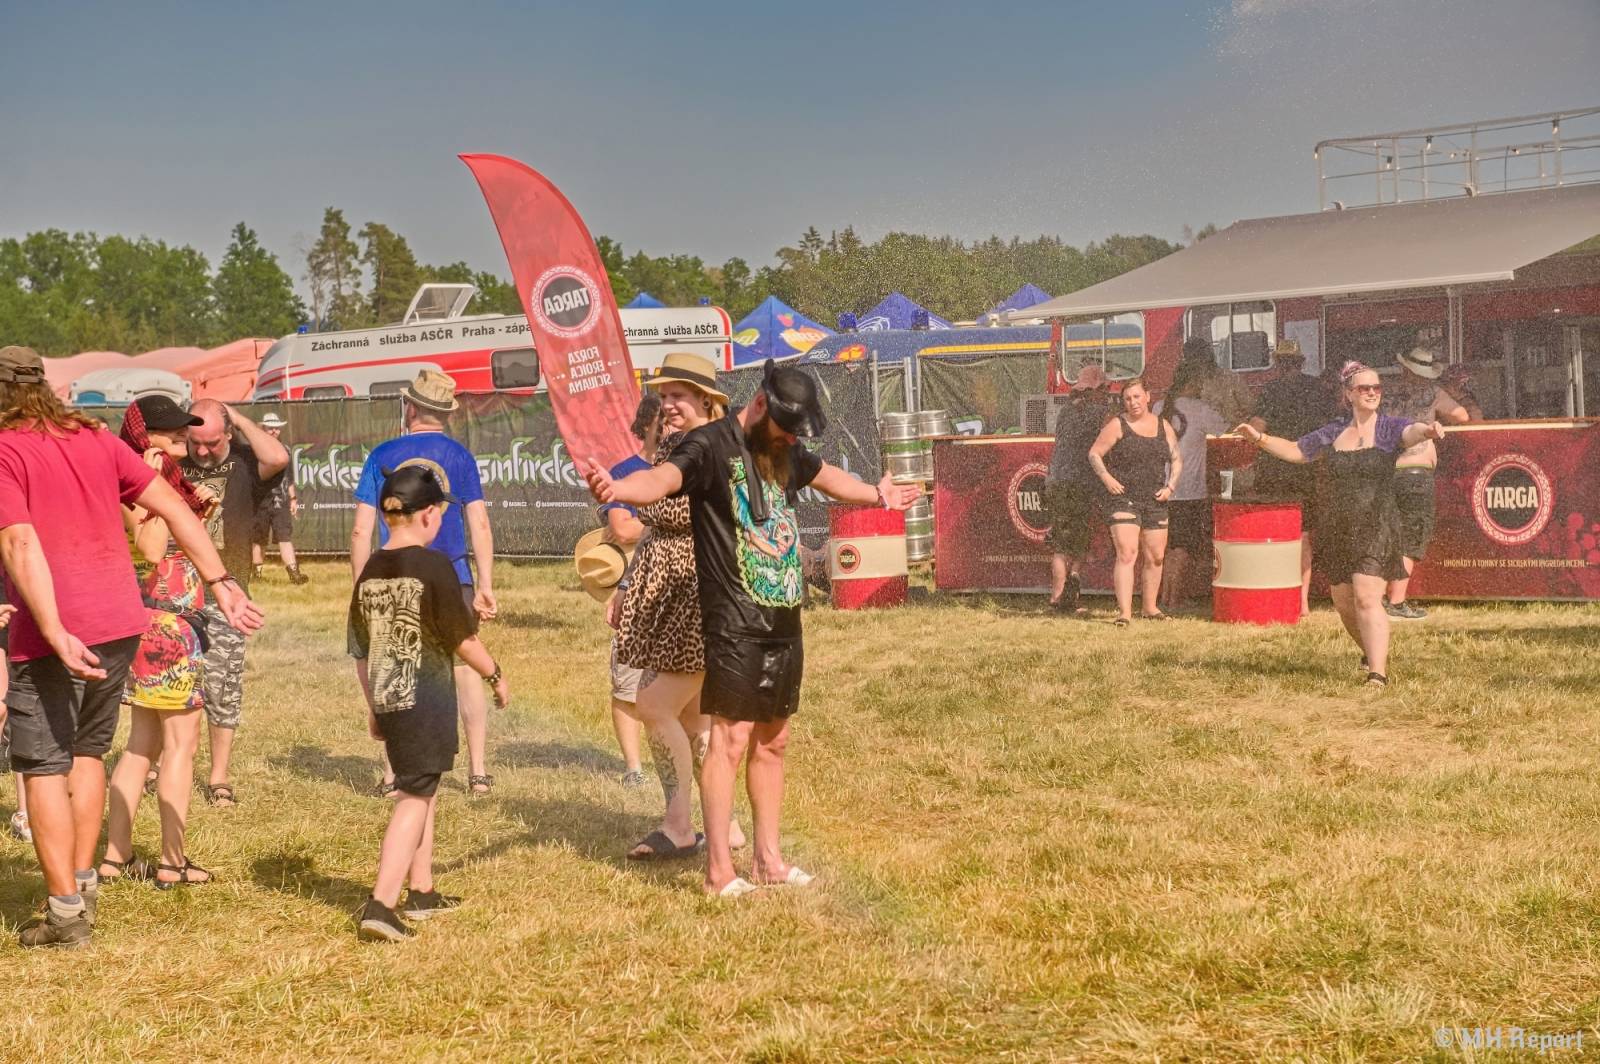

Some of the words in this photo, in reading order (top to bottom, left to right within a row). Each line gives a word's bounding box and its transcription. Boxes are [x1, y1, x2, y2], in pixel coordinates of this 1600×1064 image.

[311, 337, 370, 351] Záchranná
[379, 334, 417, 346] služba
[420, 328, 454, 342] ASČR
[462, 325, 495, 338] Praha
[505, 322, 532, 337] zápa
[623, 326, 659, 337] chranná
[663, 324, 692, 336] služba
[694, 322, 719, 335] ASČR
[1017, 491, 1045, 512] TAR
[1485, 486, 1539, 509] TARGA
